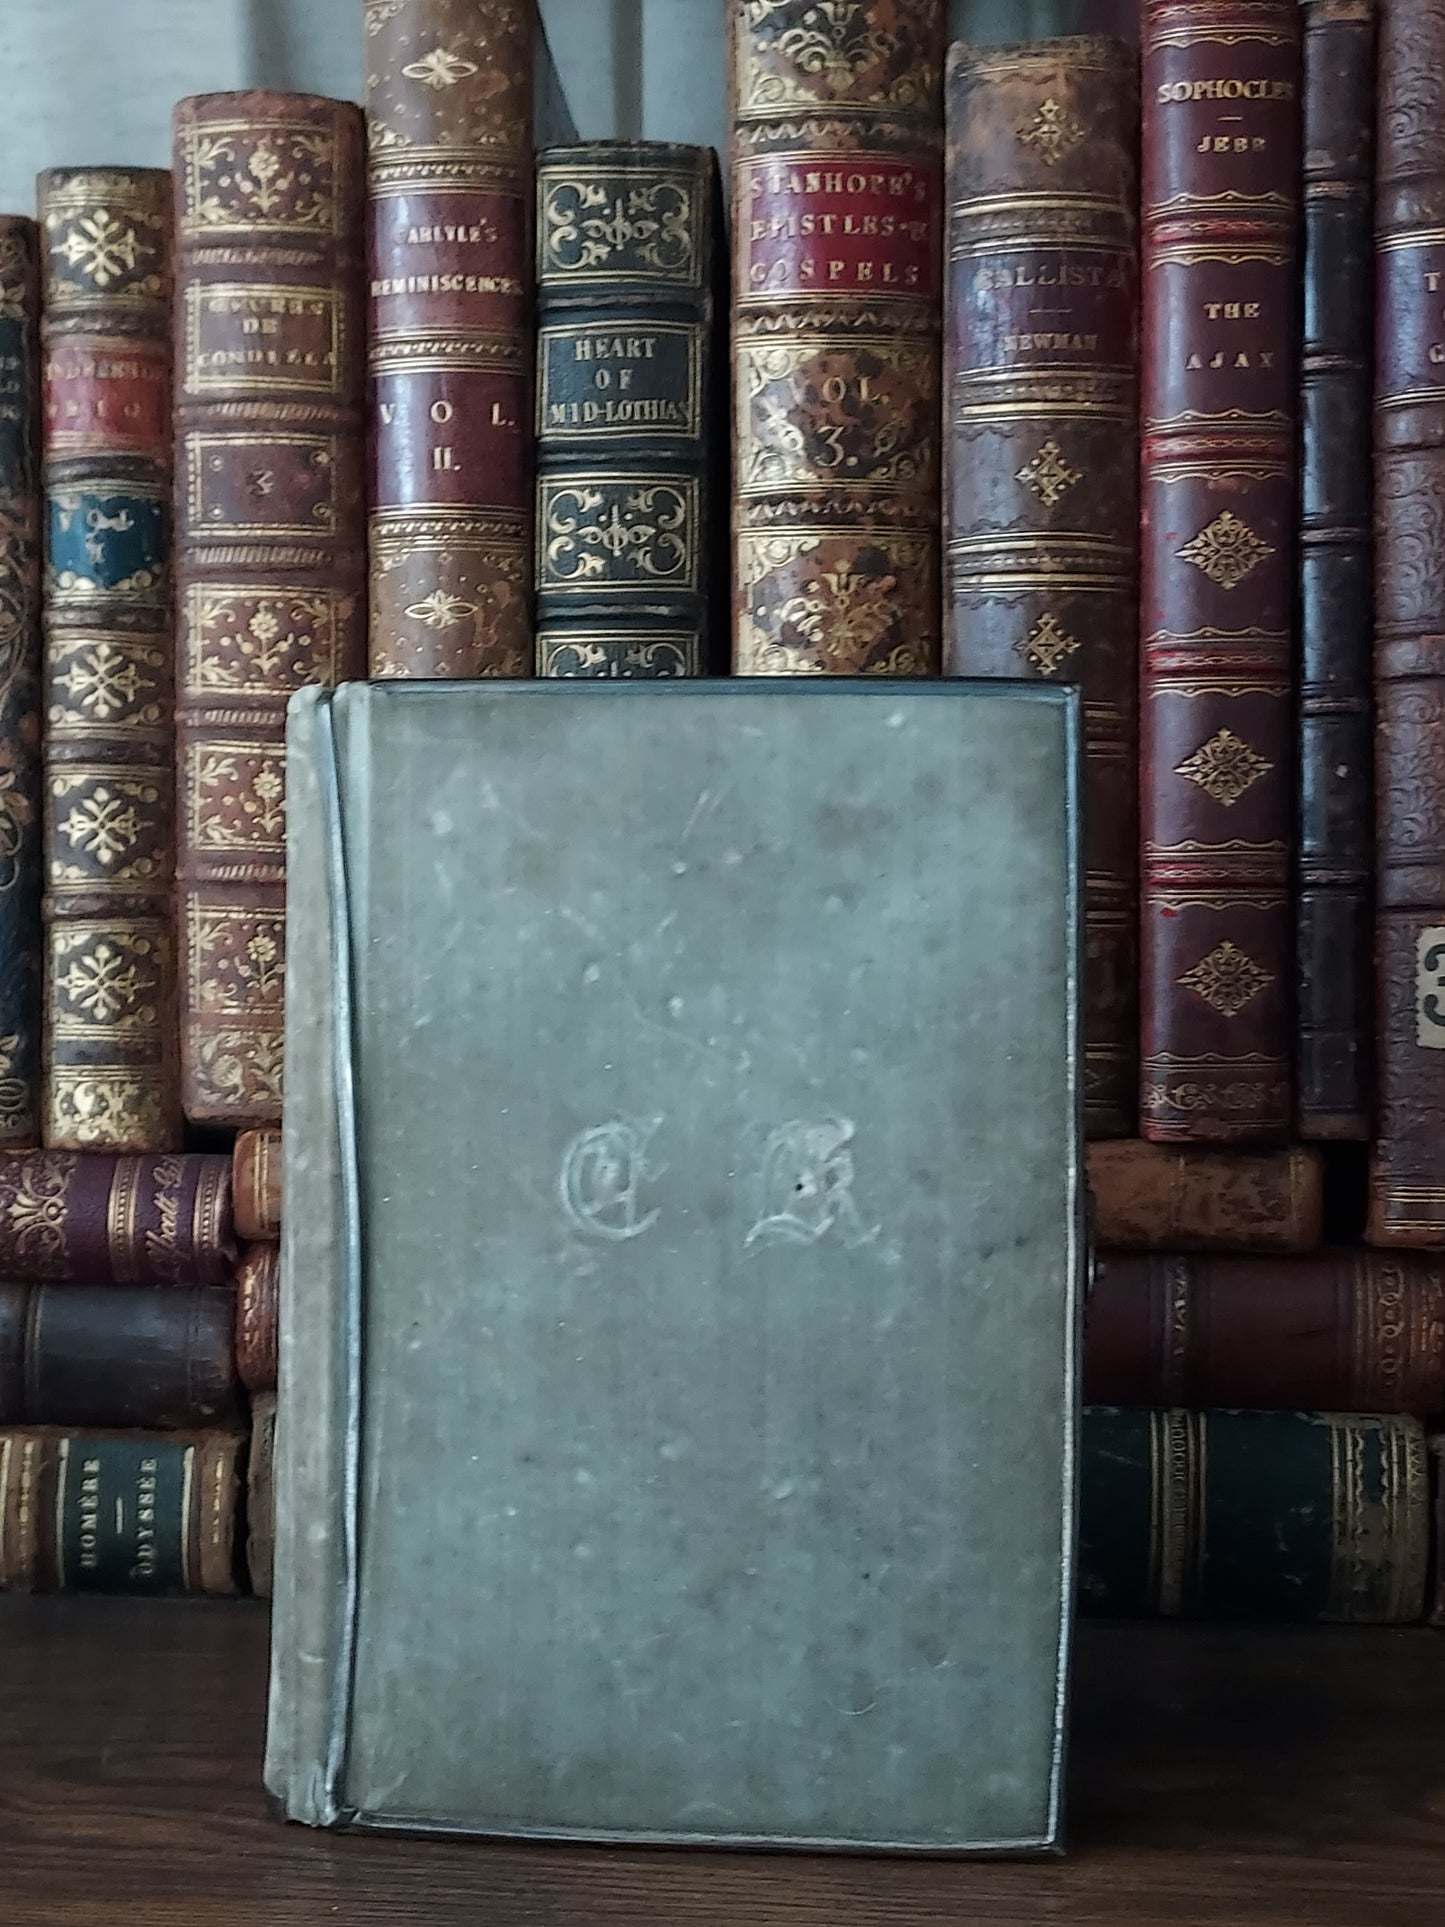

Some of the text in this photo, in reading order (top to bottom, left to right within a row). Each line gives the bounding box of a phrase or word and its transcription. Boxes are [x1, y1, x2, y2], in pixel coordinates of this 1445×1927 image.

[1158, 80, 1293, 104] SOPHOCLES
[750, 256, 921, 287] GOSPELS
[1203, 303, 1262, 319] THE
[575, 337, 656, 361] HEART
[1185, 352, 1275, 370] AJAX
[595, 369, 634, 390] OF
[433, 446, 463, 471] II.
